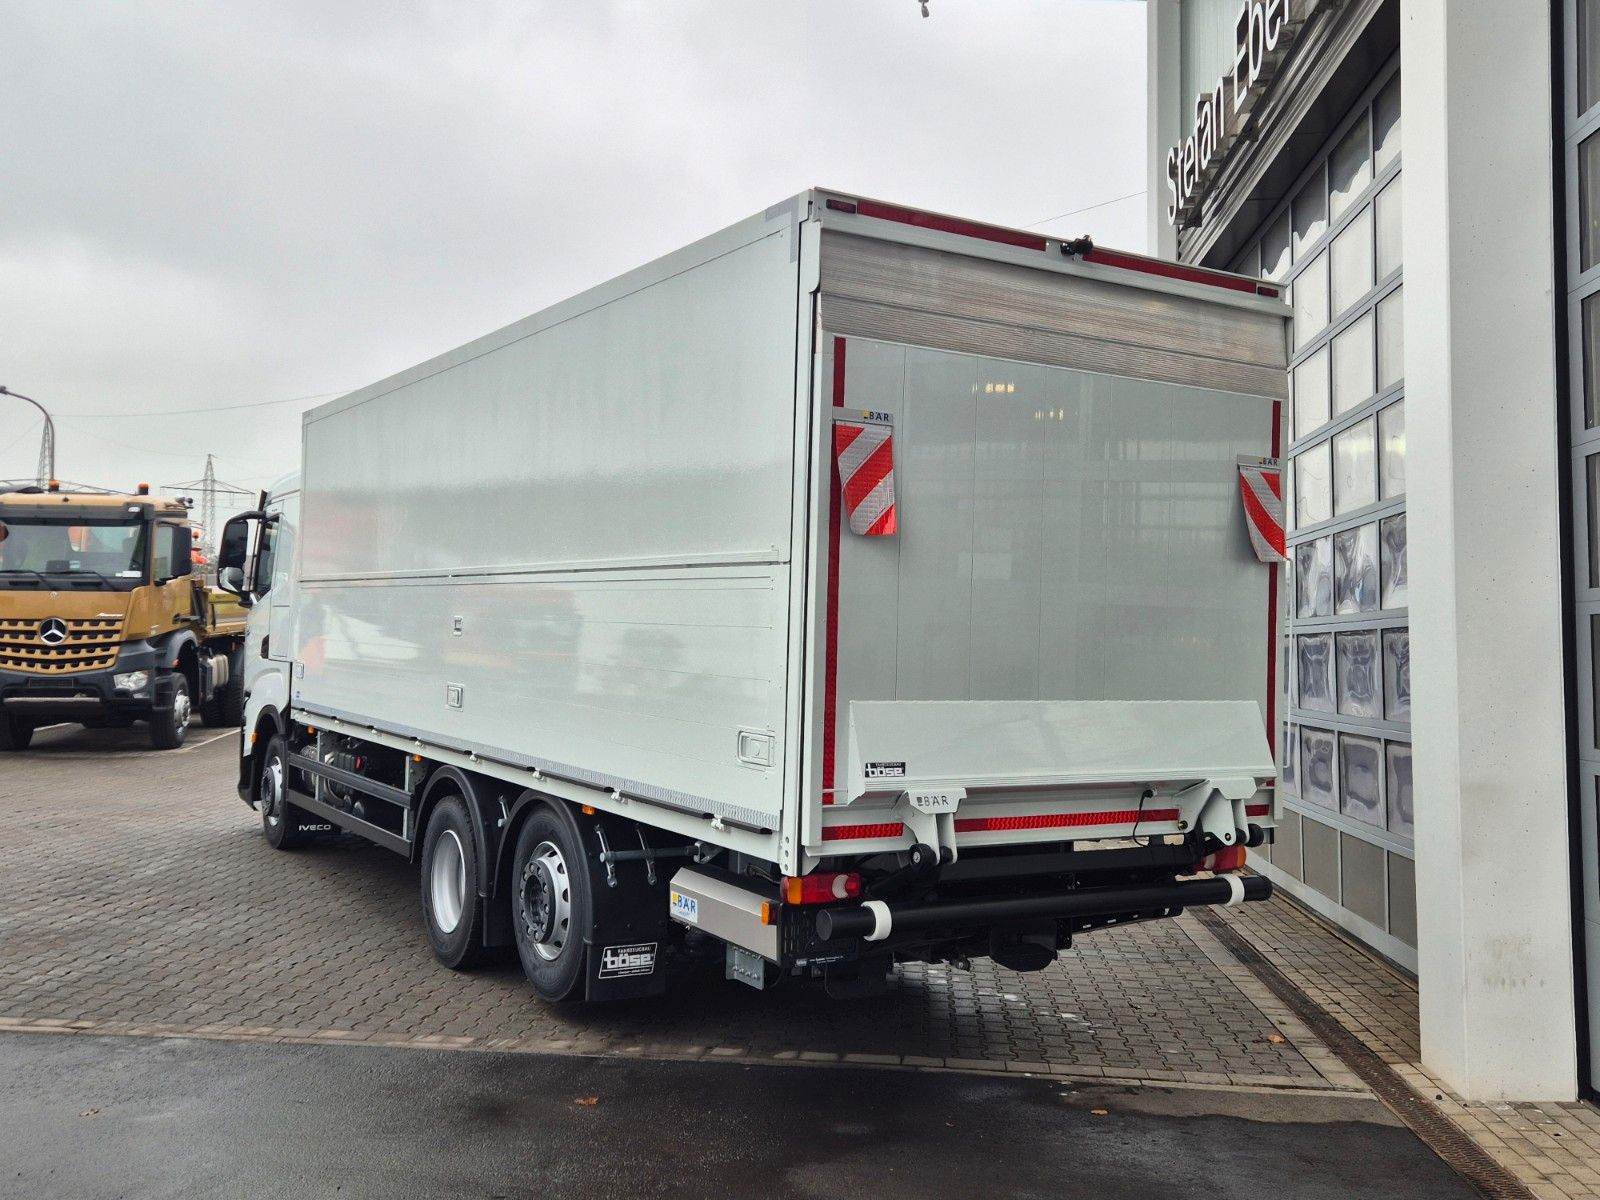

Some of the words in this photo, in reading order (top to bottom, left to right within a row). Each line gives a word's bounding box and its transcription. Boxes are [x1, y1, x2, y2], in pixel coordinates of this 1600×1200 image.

[1166, 77, 1225, 226] Stefan
[1233, 0, 1290, 114] Ebe
[869, 411, 889, 421] BÄR
[866, 763, 905, 777] böse
[923, 795, 949, 806] BÄR
[677, 894, 696, 913] BÄR
[604, 949, 654, 969] böse
